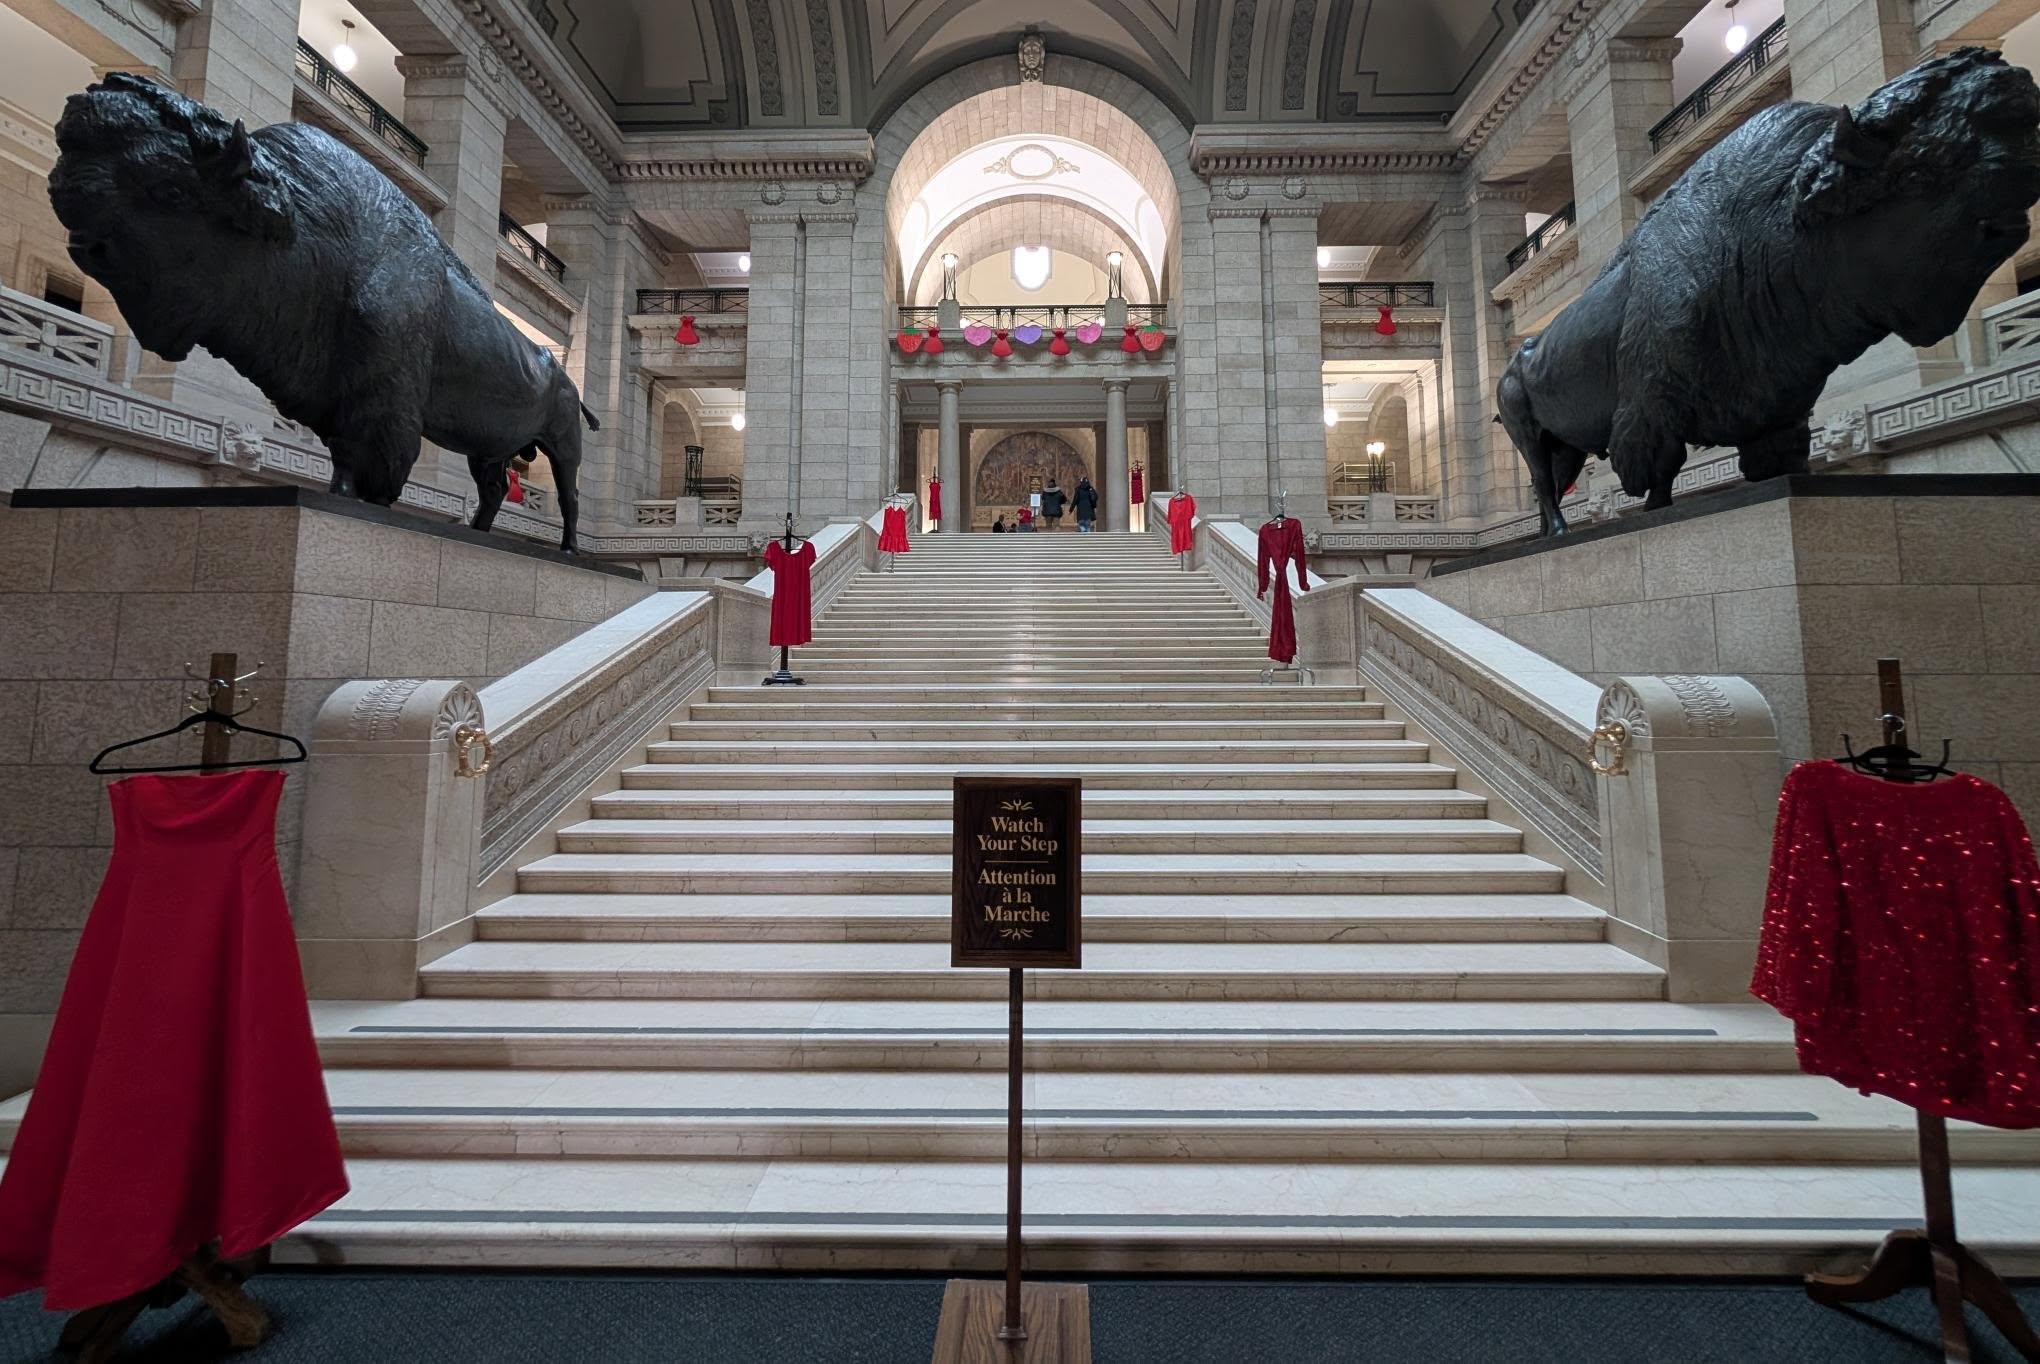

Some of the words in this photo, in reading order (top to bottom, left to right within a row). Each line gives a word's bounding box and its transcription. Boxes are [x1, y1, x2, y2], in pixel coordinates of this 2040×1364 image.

[990, 816, 1044, 833] Watch
[977, 834, 1017, 851] Your
[1020, 834, 1058, 855] Step
[978, 868, 1056, 885] Attention
[1002, 887, 1011, 903] à
[1017, 887, 1032, 903] la
[984, 905, 1050, 922] Marche
